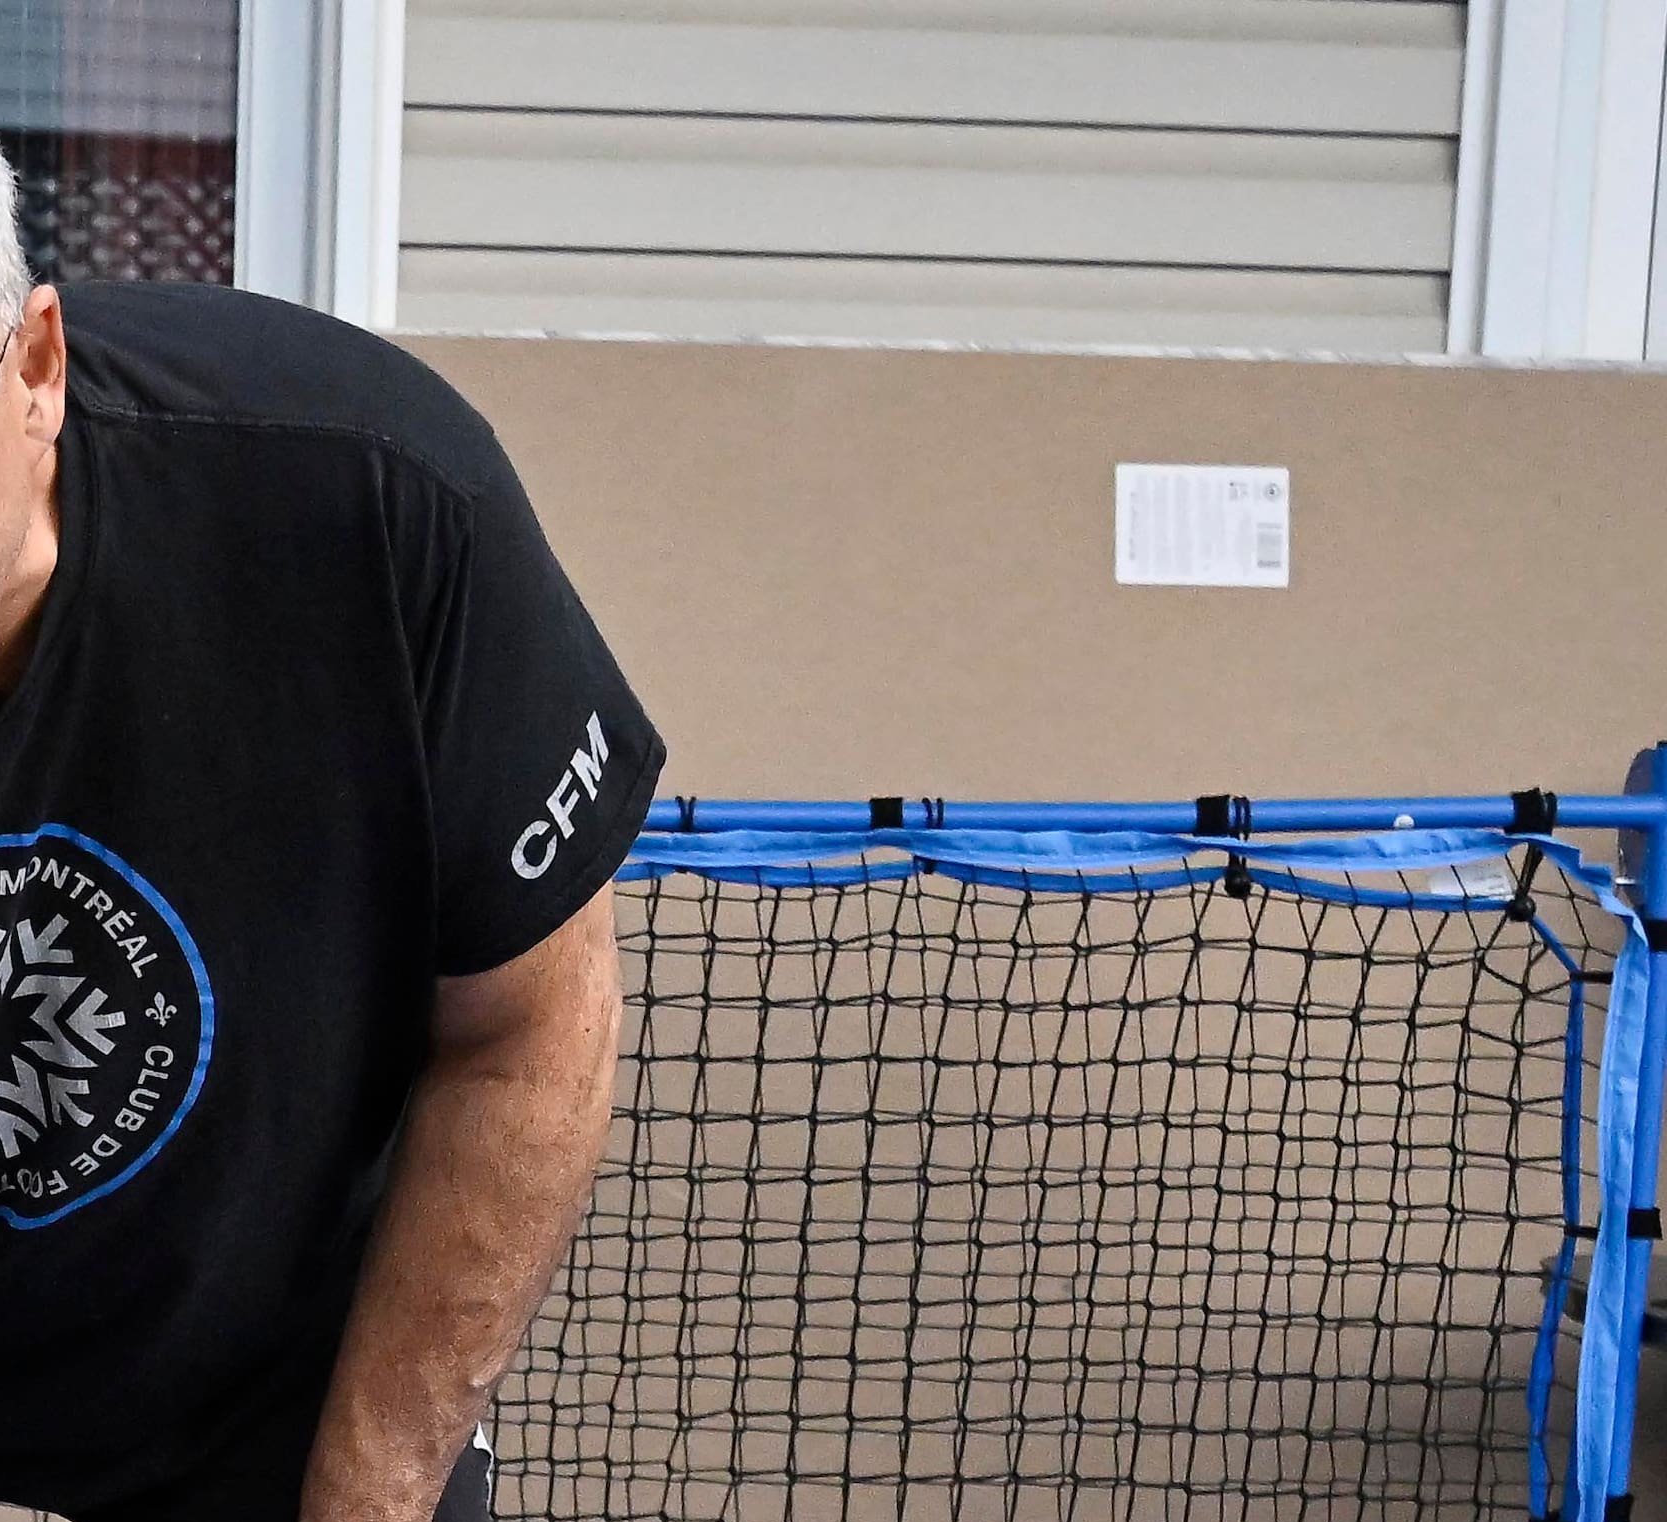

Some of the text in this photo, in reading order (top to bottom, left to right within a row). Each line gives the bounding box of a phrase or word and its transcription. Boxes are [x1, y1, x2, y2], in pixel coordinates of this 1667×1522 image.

[511, 710, 610, 880] CFM
[115, 1044, 175, 1132] CLUB
[69, 1137, 123, 1178] DE
